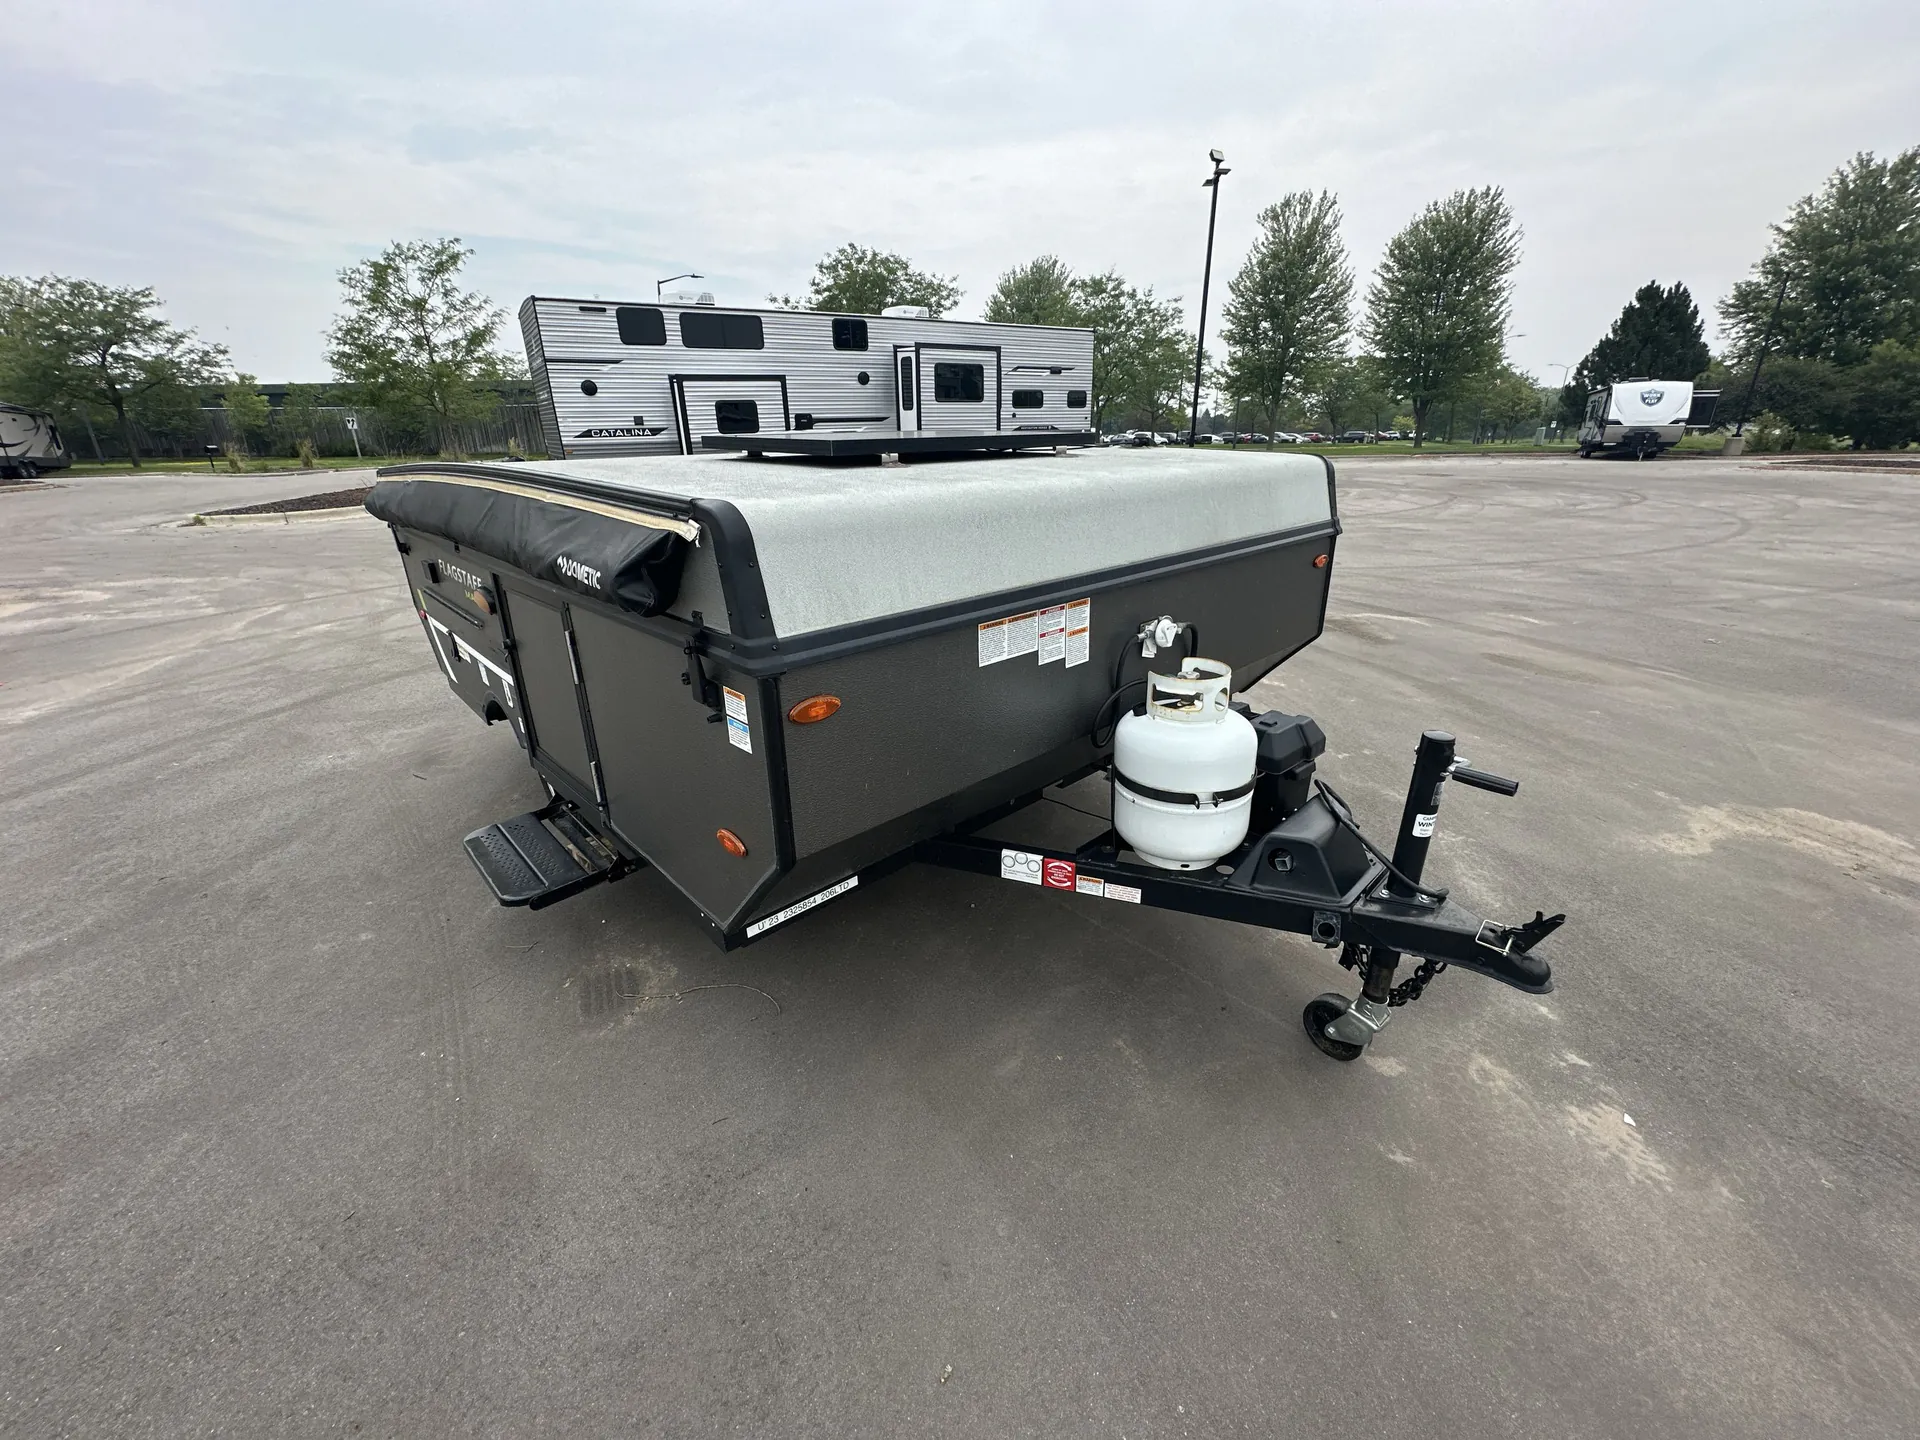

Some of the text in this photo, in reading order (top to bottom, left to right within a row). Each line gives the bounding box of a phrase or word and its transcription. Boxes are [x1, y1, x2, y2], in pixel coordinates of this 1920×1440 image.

[591, 428, 652, 437] CATALINA
[438, 558, 482, 591] FLAGSTAFF
[566, 558, 602, 590] DOMETIC
[783, 897, 817, 919] 2325854
[820, 881, 849, 901] 206LTD
